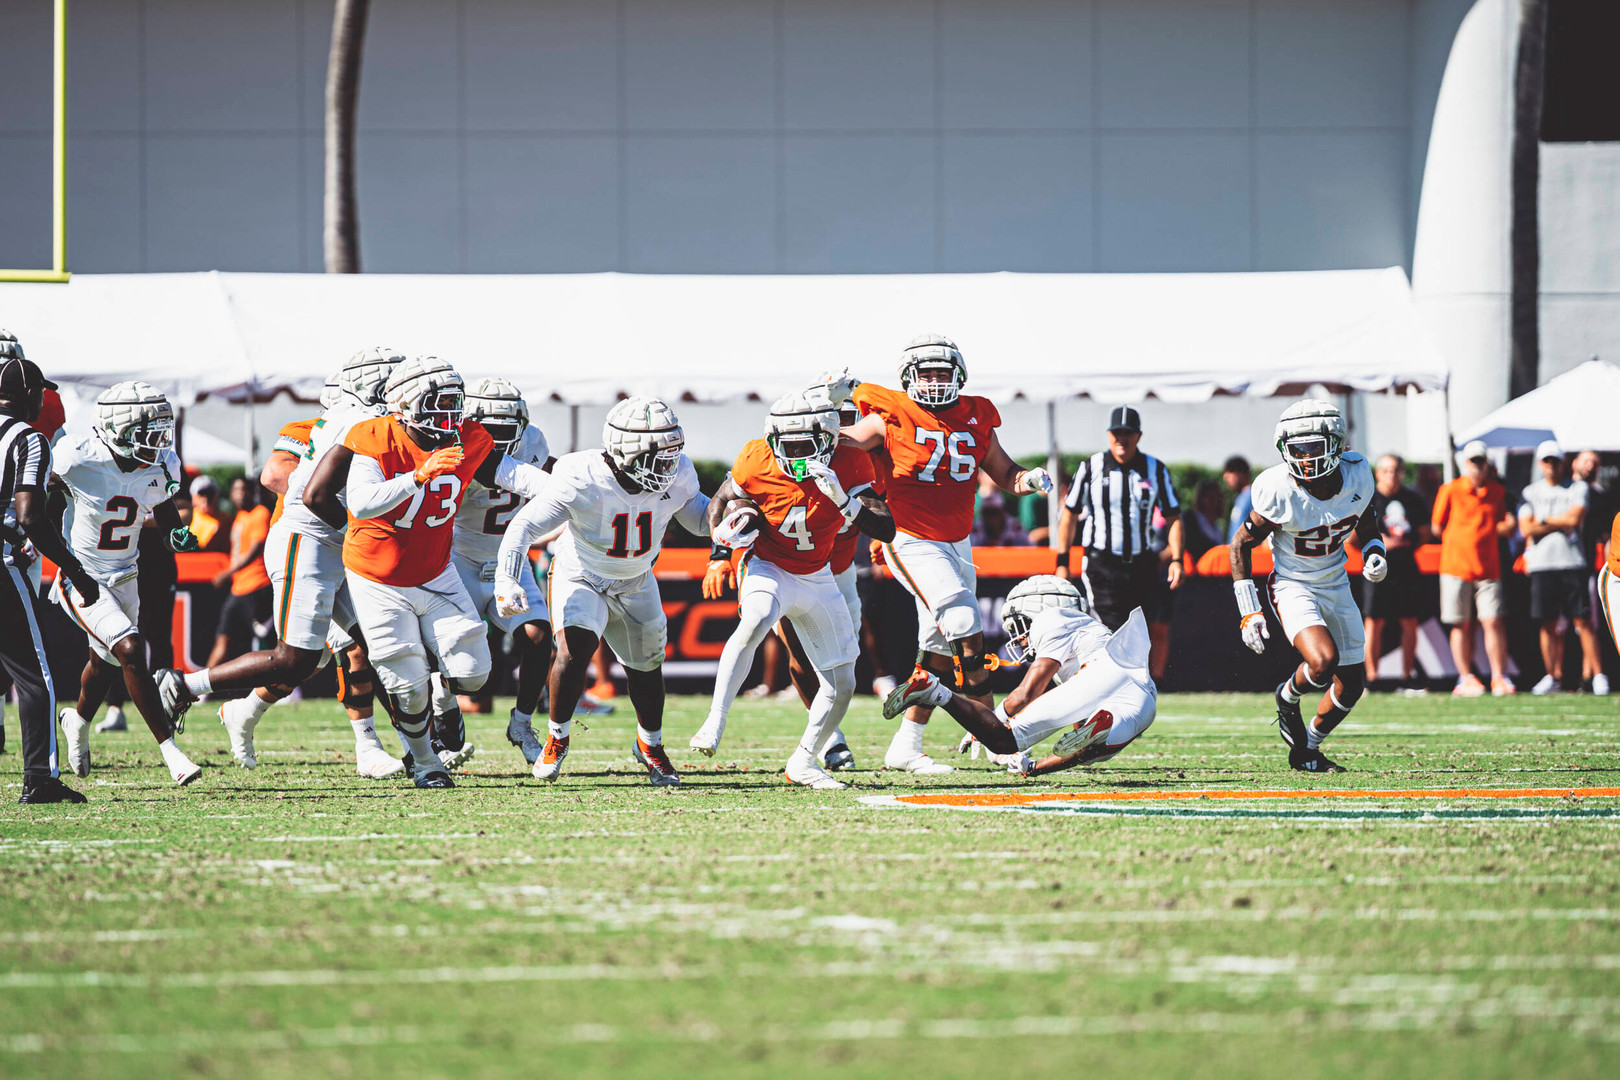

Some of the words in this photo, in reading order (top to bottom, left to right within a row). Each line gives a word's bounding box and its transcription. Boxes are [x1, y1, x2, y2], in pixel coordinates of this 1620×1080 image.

[915, 426, 976, 482] 76
[97, 495, 139, 550] 2
[394, 471, 462, 530] 73
[482, 488, 531, 536] 2
[606, 511, 653, 558] 11
[777, 505, 816, 551] 4
[1294, 514, 1360, 557] 22
